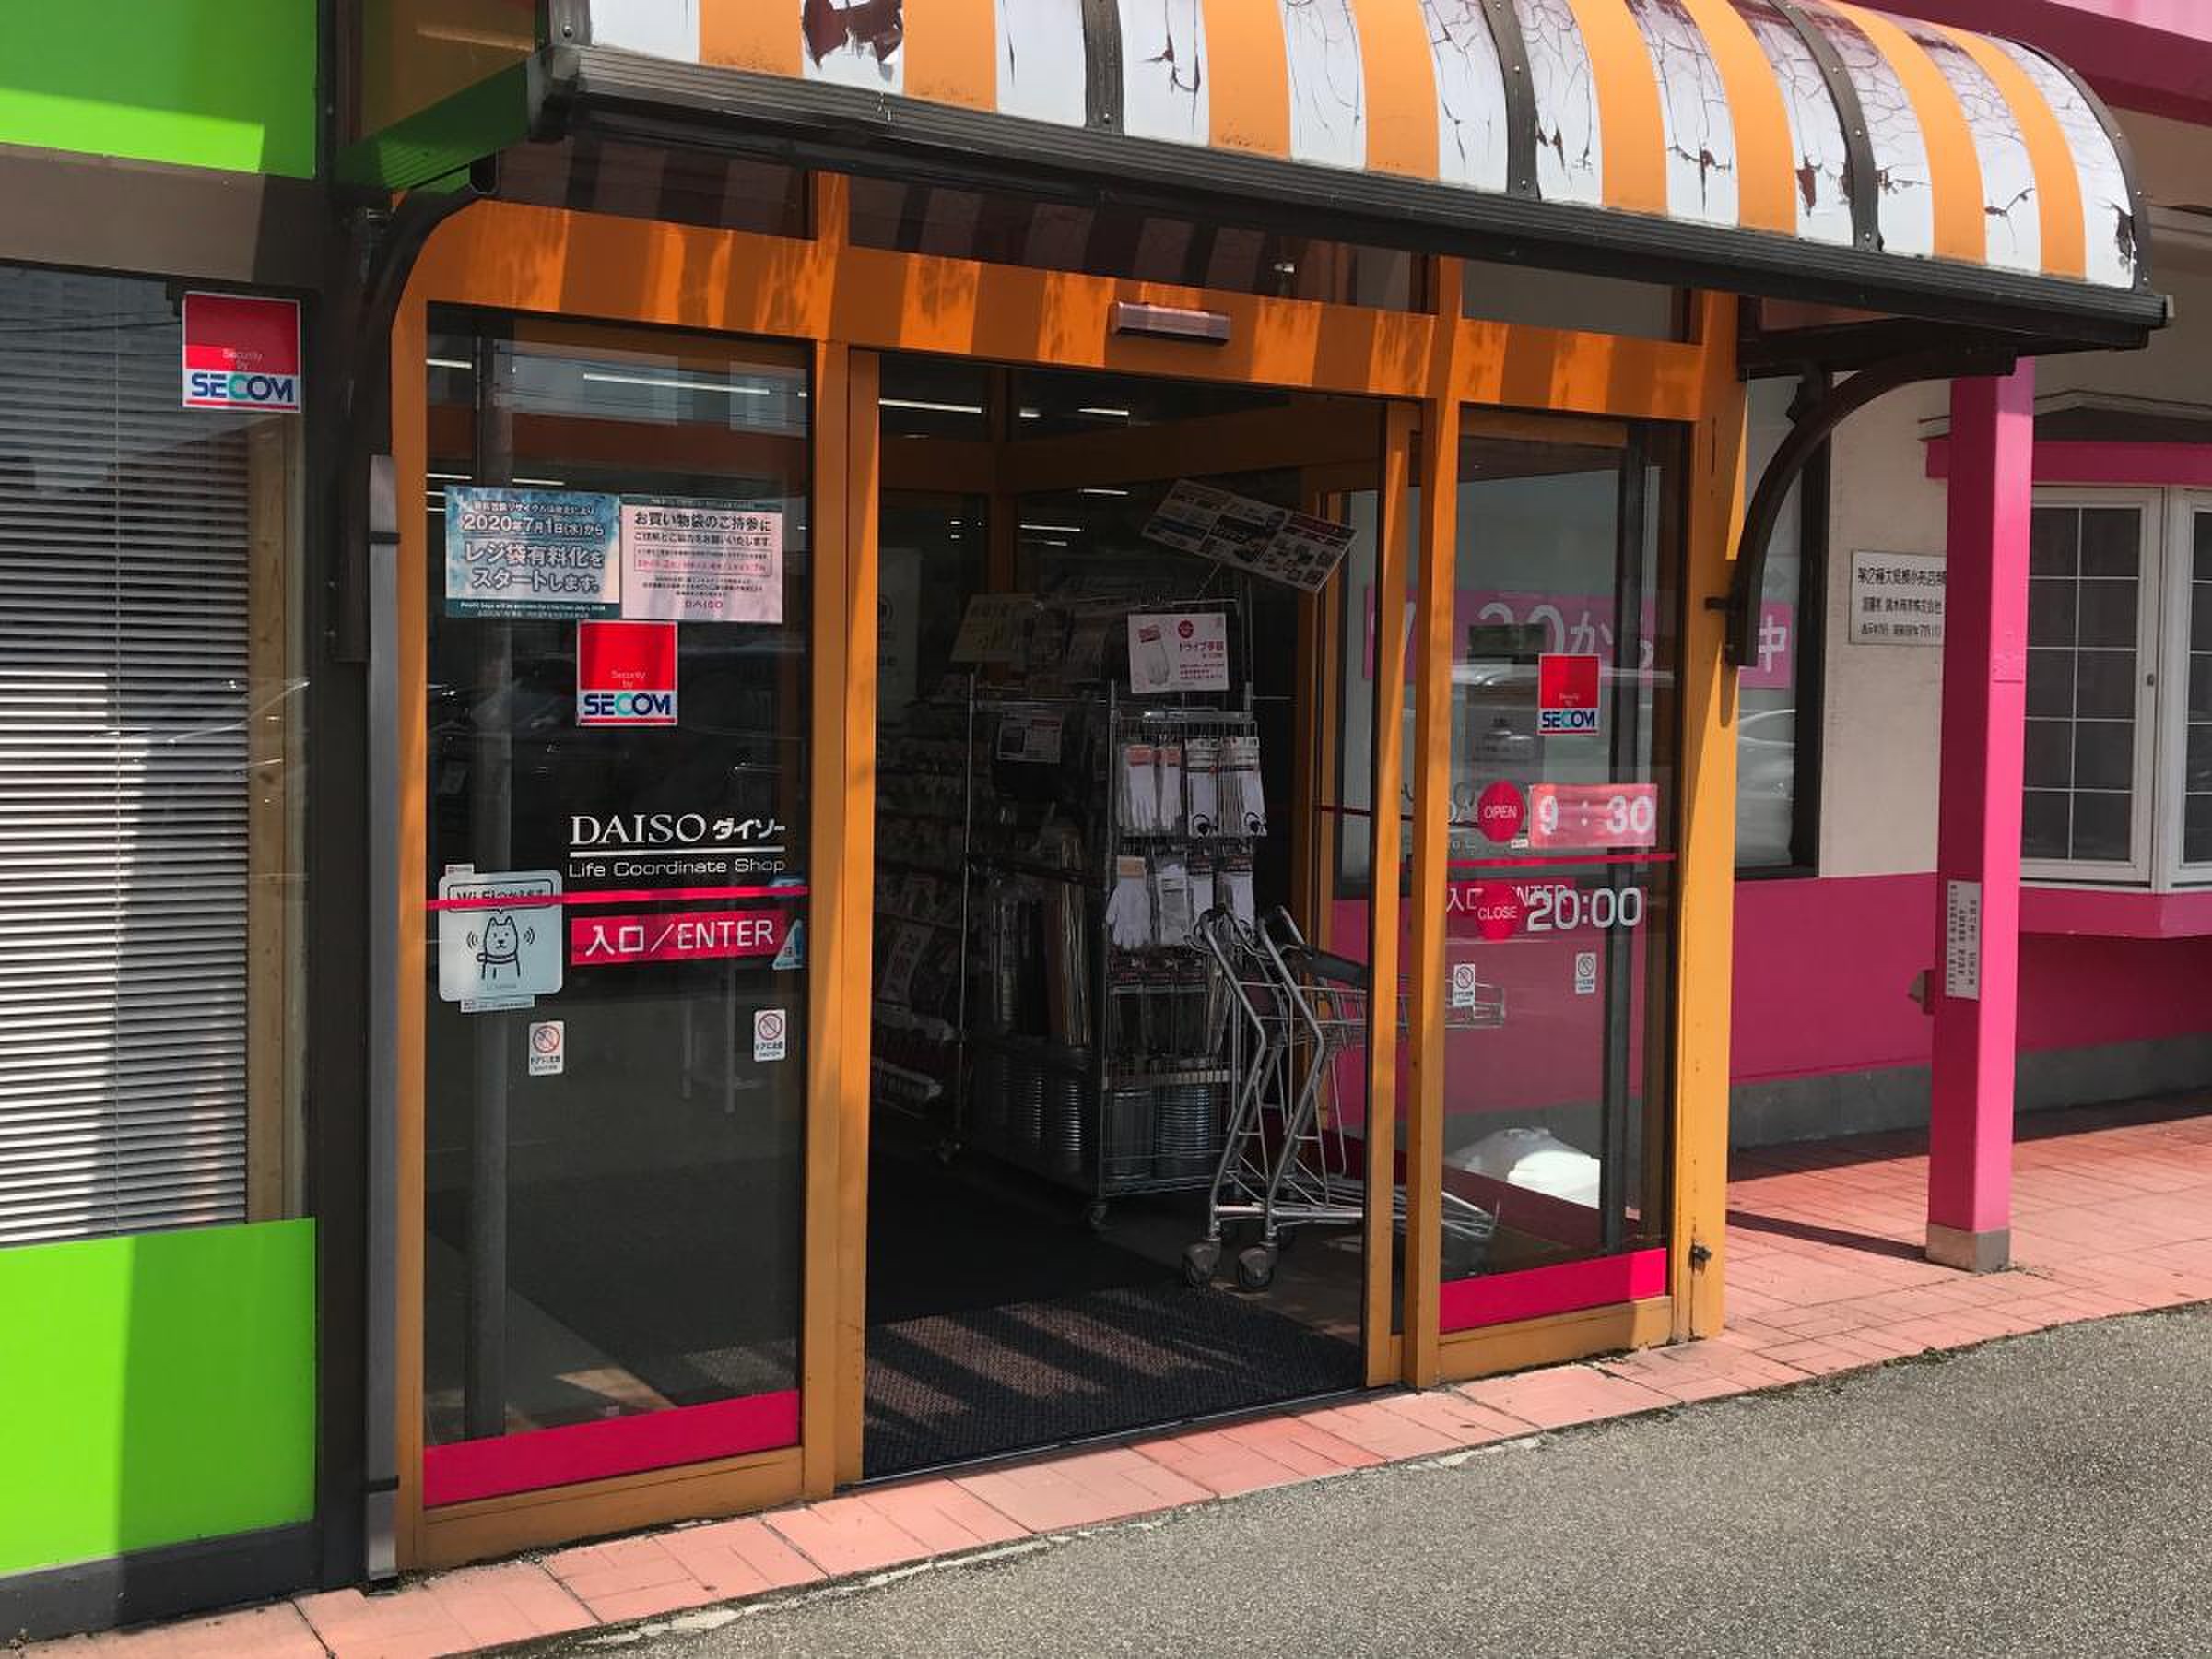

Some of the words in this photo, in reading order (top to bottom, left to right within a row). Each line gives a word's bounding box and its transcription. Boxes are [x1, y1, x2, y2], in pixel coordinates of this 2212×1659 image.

[192, 372, 294, 402] SECOM
[465, 541, 604, 568] レジ袋有料化を
[471, 568, 600, 593] スタートします。
[584, 693, 670, 715] SECOM
[1542, 711, 1595, 728] SECOM
[1483, 805, 1517, 819] OPEN
[570, 813, 707, 846] DAISO
[712, 818, 786, 841] ダイソー
[569, 862, 606, 877] Life
[613, 859, 727, 877] Coordinate
[735, 857, 785, 872] Shop
[1477, 906, 1518, 921] CLOSE
[1527, 887, 1641, 932] 20:00
